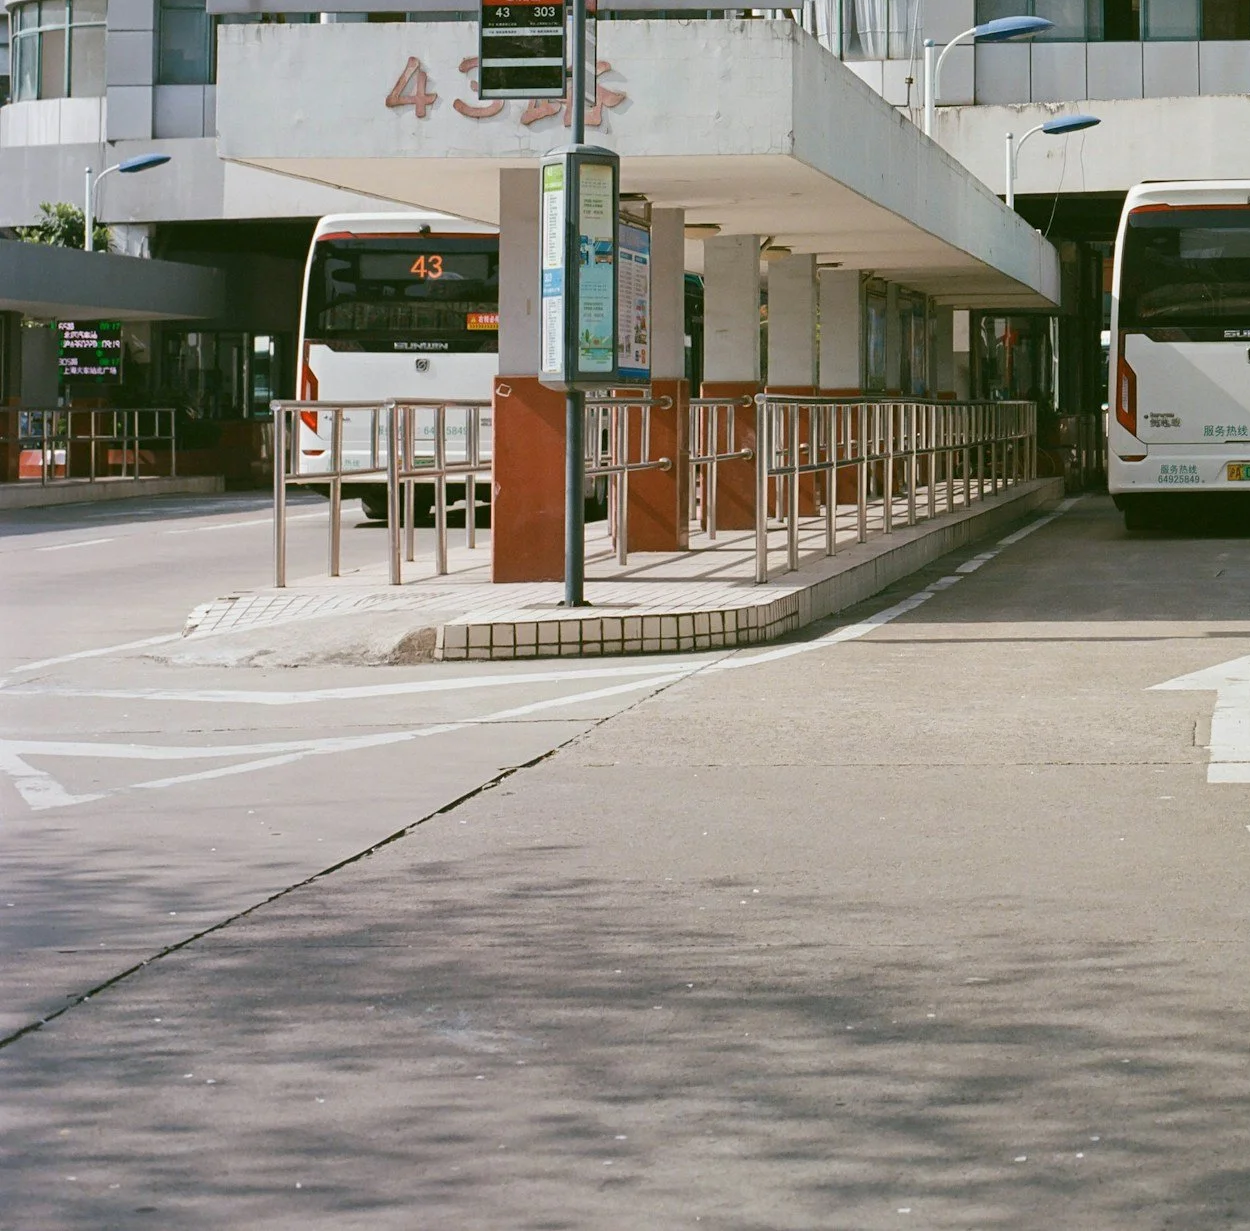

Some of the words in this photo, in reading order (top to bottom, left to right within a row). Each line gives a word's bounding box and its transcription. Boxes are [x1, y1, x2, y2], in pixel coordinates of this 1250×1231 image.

[495, 6, 510, 18] 43
[533, 6, 556, 17] 303
[410, 254, 444, 279] 43
[393, 341, 449, 350] SUNWIN
[1160, 464, 1198, 474] 服务热线
[1158, 474, 1200, 484] 64925849
